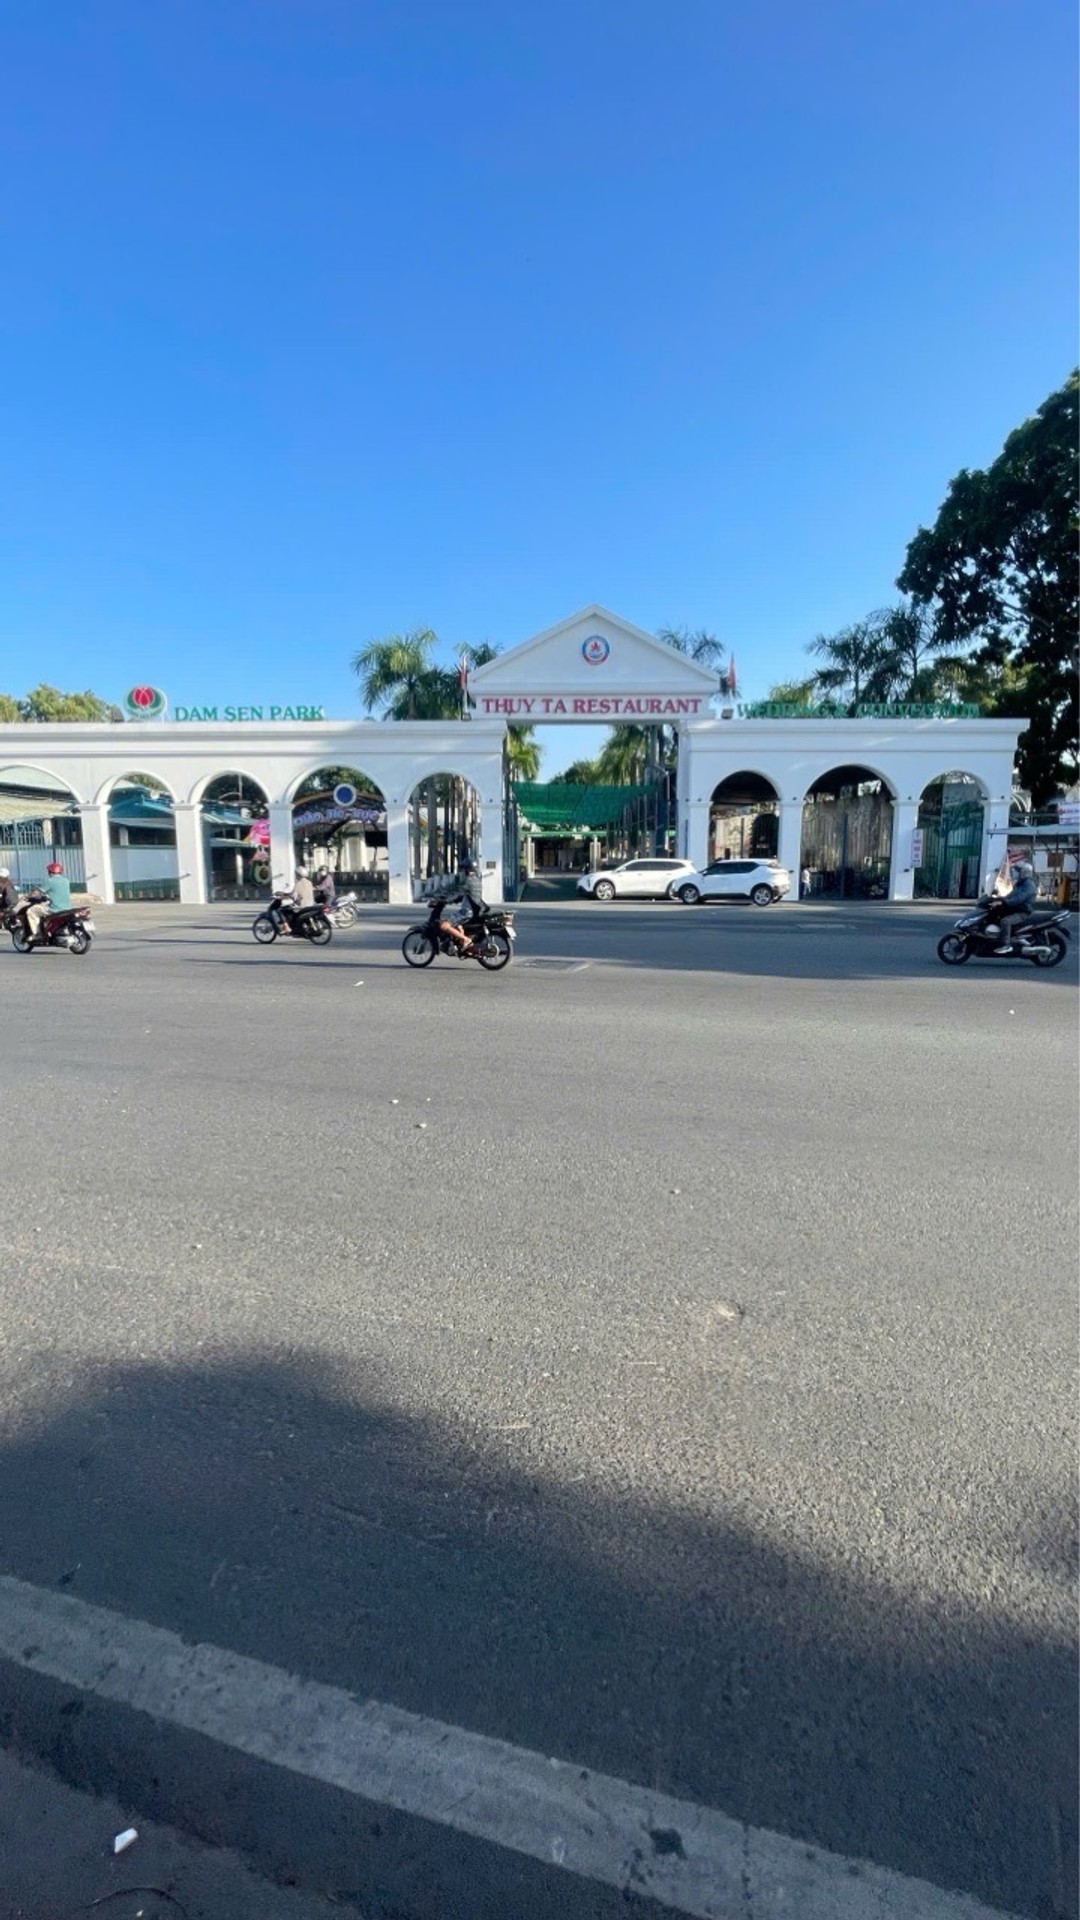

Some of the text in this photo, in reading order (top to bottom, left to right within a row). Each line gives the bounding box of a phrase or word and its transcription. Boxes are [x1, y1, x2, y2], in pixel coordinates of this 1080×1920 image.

[175, 706, 217, 721] DAM
[224, 706, 263, 722] SEN
[270, 705, 324, 720] PARK
[542, 698, 568, 713] TA
[573, 698, 702, 714] RESTAURANT
